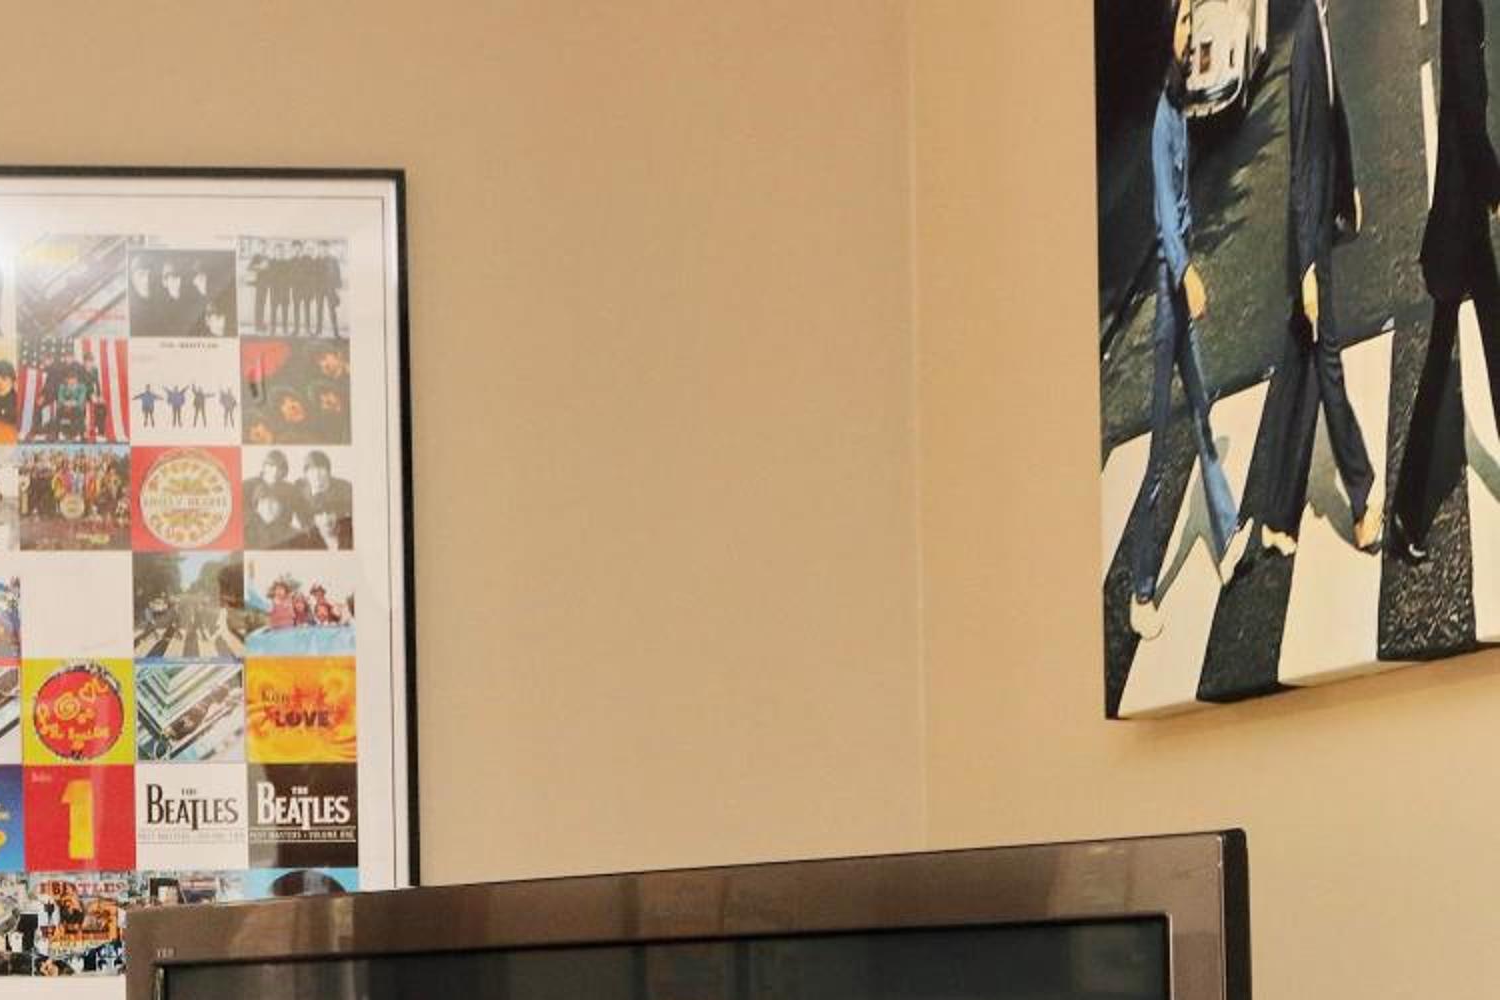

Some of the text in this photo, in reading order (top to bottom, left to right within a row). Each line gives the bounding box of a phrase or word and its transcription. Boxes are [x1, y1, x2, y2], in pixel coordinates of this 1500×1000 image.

[275, 710, 331, 728] LOVE
[60, 779, 96, 860] 1
[146, 783, 240, 831] BEATLES
[256, 781, 351, 830] BEATLES
